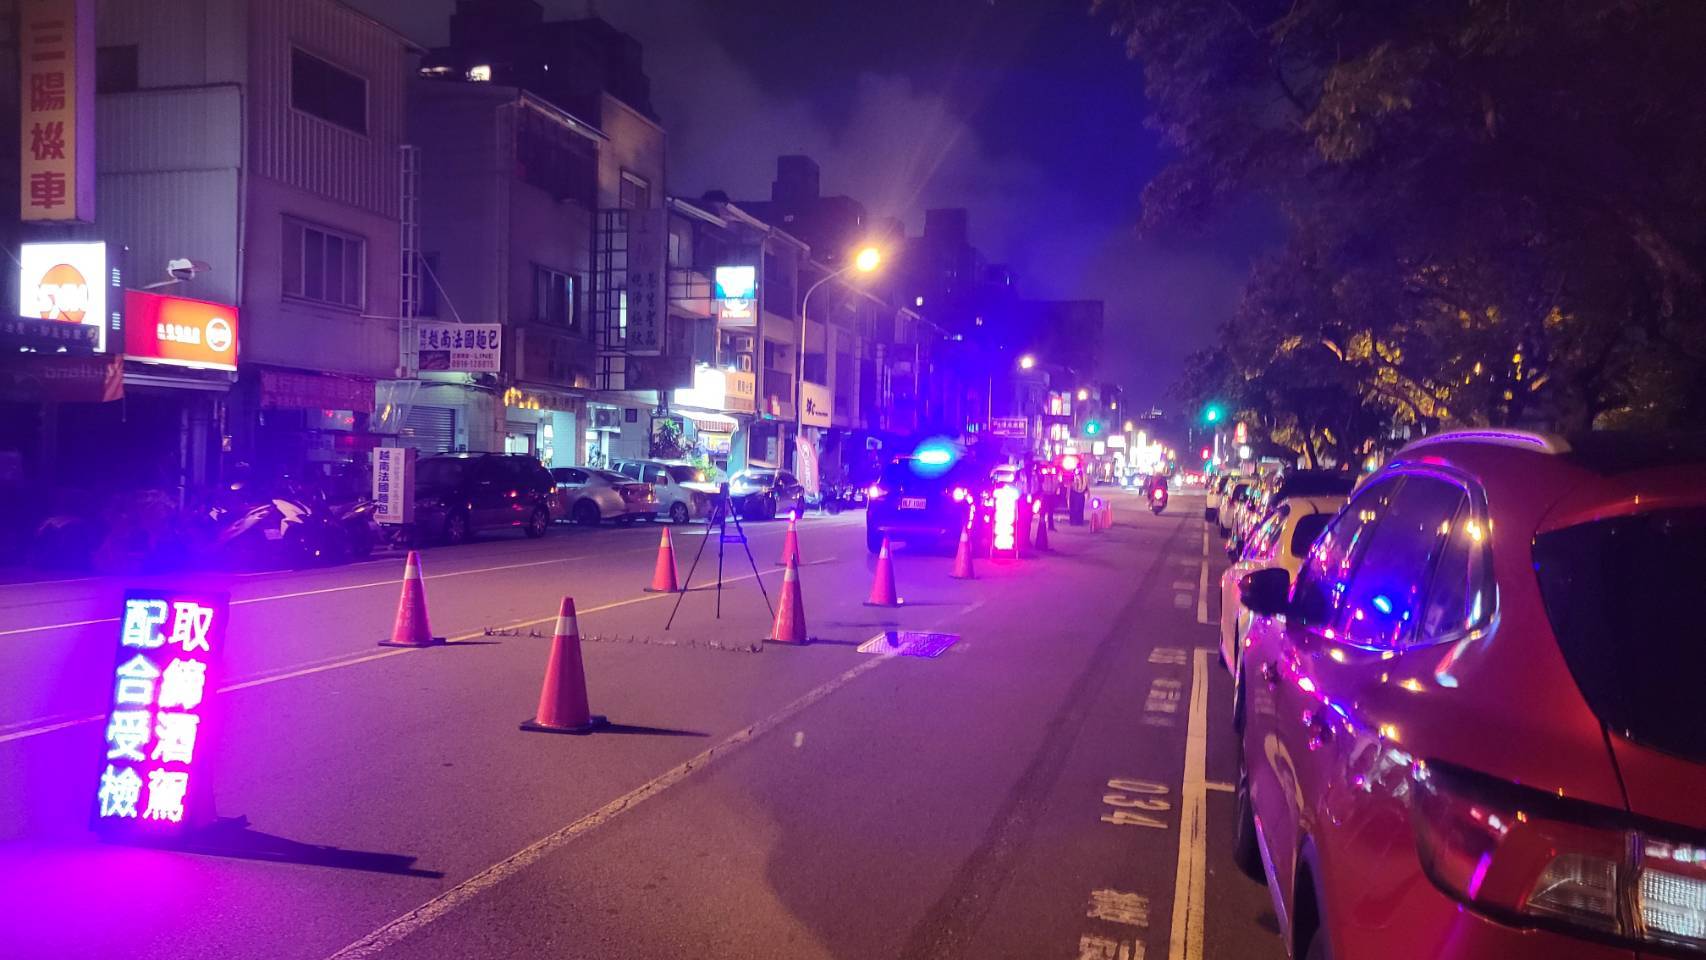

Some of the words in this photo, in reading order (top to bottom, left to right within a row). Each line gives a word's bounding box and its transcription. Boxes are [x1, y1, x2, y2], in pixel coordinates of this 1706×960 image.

[31, 20, 66, 209] 三陽機車
[96, 597, 170, 818] 配合受檢
[142, 601, 215, 822] 取締酒駕
[1100, 778, 1171, 829] 034
